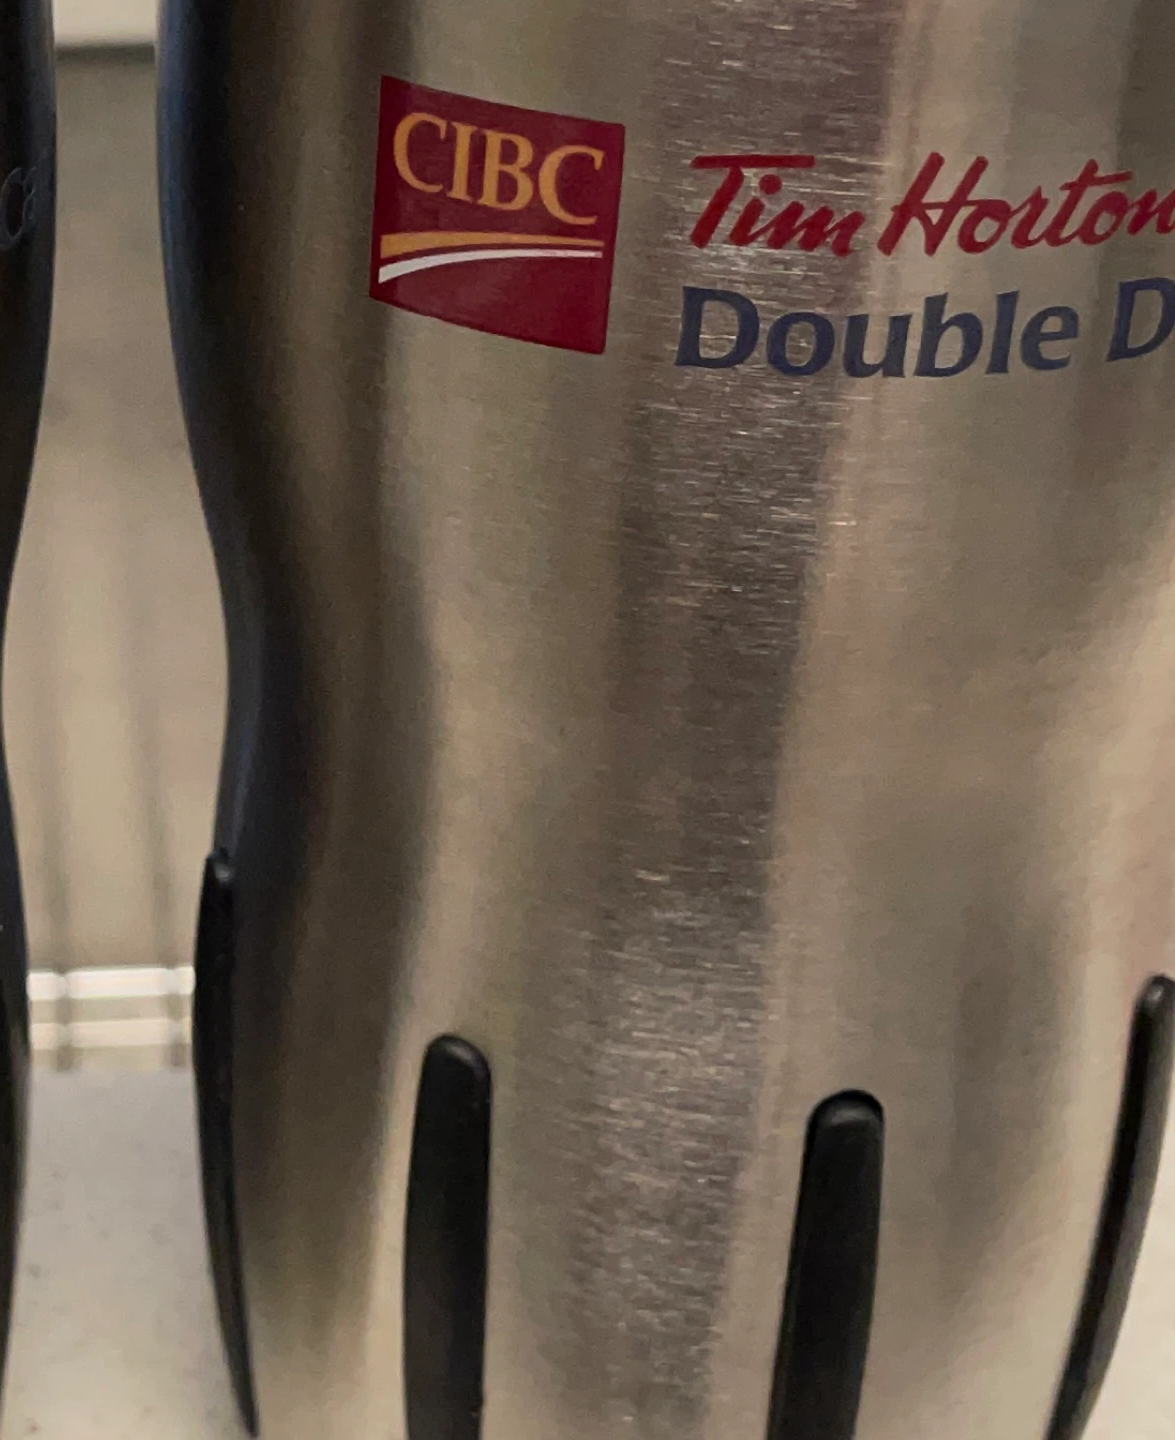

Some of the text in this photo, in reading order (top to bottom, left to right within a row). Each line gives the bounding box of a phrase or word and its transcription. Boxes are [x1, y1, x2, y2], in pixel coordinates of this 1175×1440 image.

[393, 112, 603, 225] CIBC
[691, 154, 863, 257] Tim
[674, 285, 1079, 379] Double
